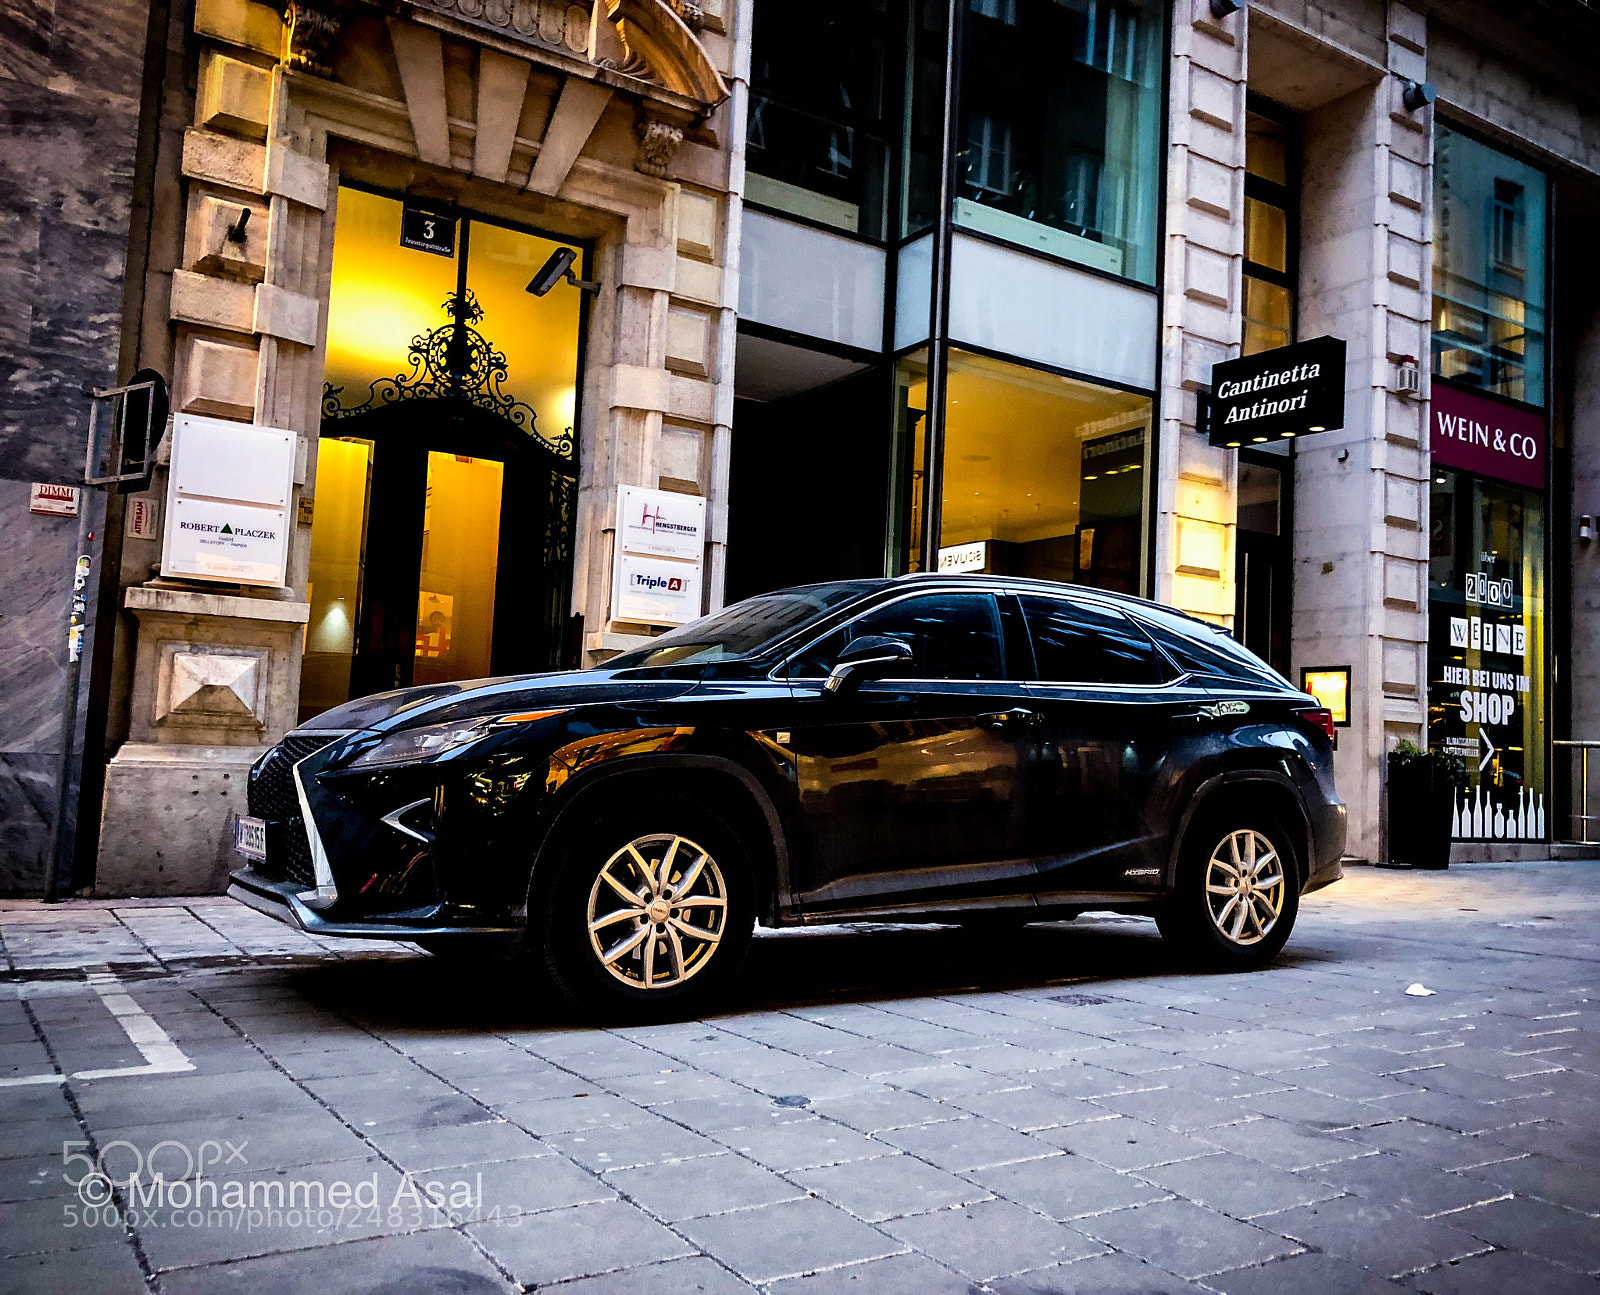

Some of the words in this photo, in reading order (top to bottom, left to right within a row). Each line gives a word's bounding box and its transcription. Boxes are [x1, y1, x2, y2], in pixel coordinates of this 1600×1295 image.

[423, 220, 435, 239] 3
[1217, 363, 1321, 399] Cantinetta
[1223, 389, 1308, 424] Antinori
[1437, 411, 1489, 448] WEIN
[1493, 428, 1507, 452] &
[1509, 433, 1537, 460] CO
[40, 485, 74, 497] DIMMI
[134, 501, 143, 535] ATTENSAM
[180, 521, 220, 533] ROBERT
[235, 527, 276, 540] PLACZEK
[655, 521, 697, 533] HENGSTBERGER
[636, 574, 667, 590] Triple
[1466, 574, 1512, 606] 2000
[1451, 620, 1525, 652] WEINE
[1443, 665, 1470, 686] HIER
[1472, 669, 1490, 688] BEI
[1492, 671, 1515, 691] UNS
[1516, 674, 1530, 692] IM
[1460, 690, 1515, 726] SHOP
[1124, 868, 1160, 876] HYBRID
